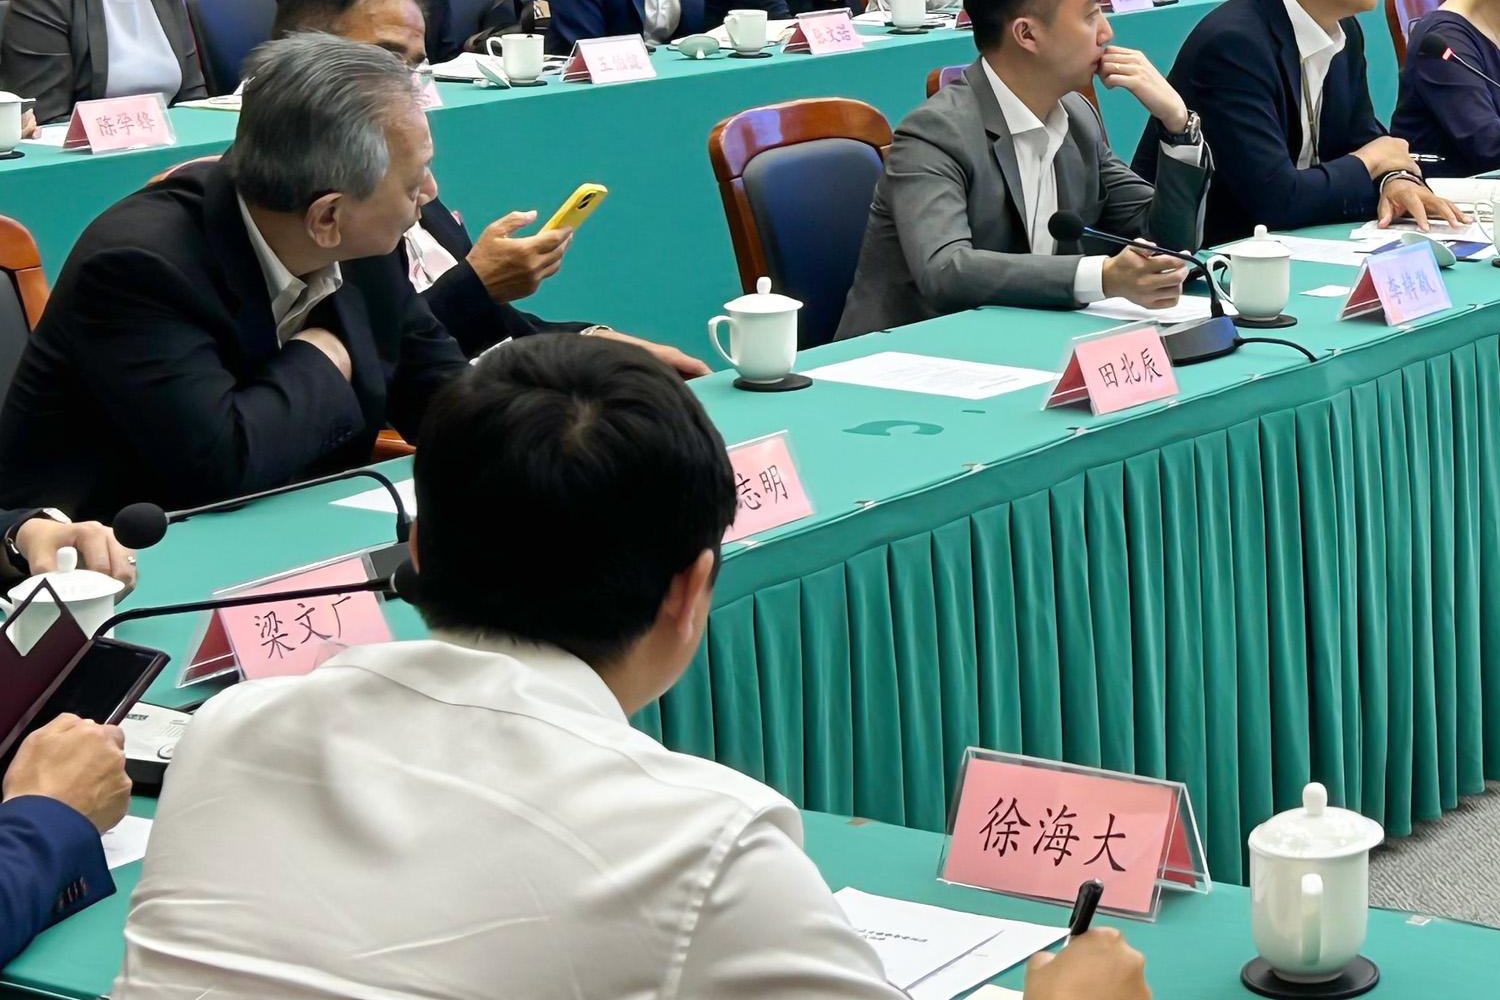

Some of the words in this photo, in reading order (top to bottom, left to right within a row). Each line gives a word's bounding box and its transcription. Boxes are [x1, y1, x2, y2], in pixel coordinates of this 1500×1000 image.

[1098, 347, 1162, 388] 田北辰
[979, 796, 1127, 873] 徐海大
